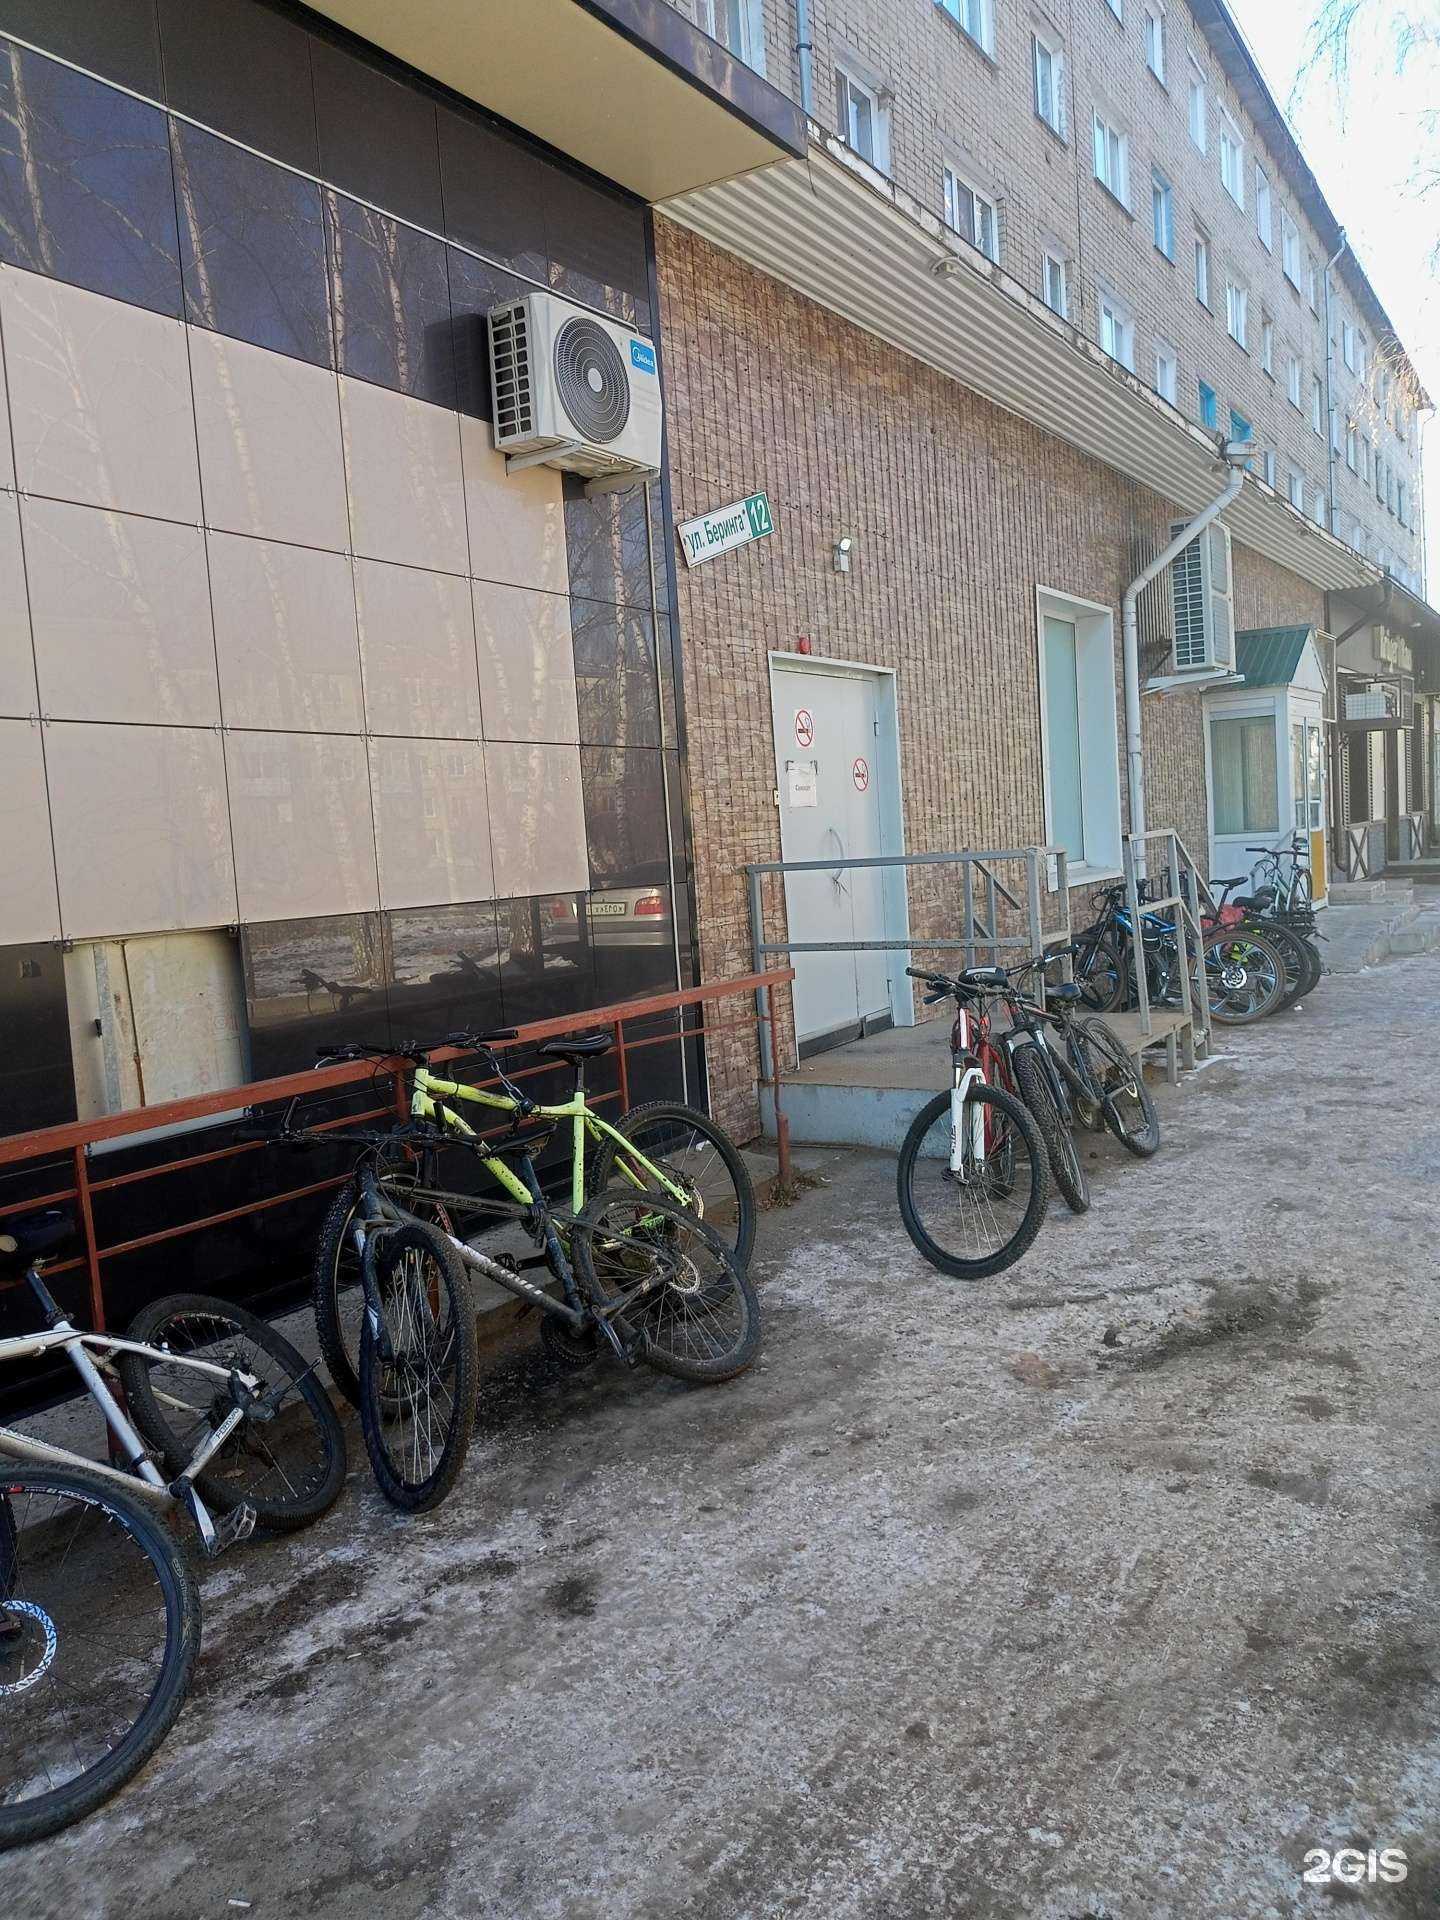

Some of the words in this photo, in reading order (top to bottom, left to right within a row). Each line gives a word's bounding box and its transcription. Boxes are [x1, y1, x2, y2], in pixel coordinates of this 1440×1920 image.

[686, 531, 706, 557] ул.
[704, 514, 745, 546] Беринга
[751, 499, 769, 532] 12
